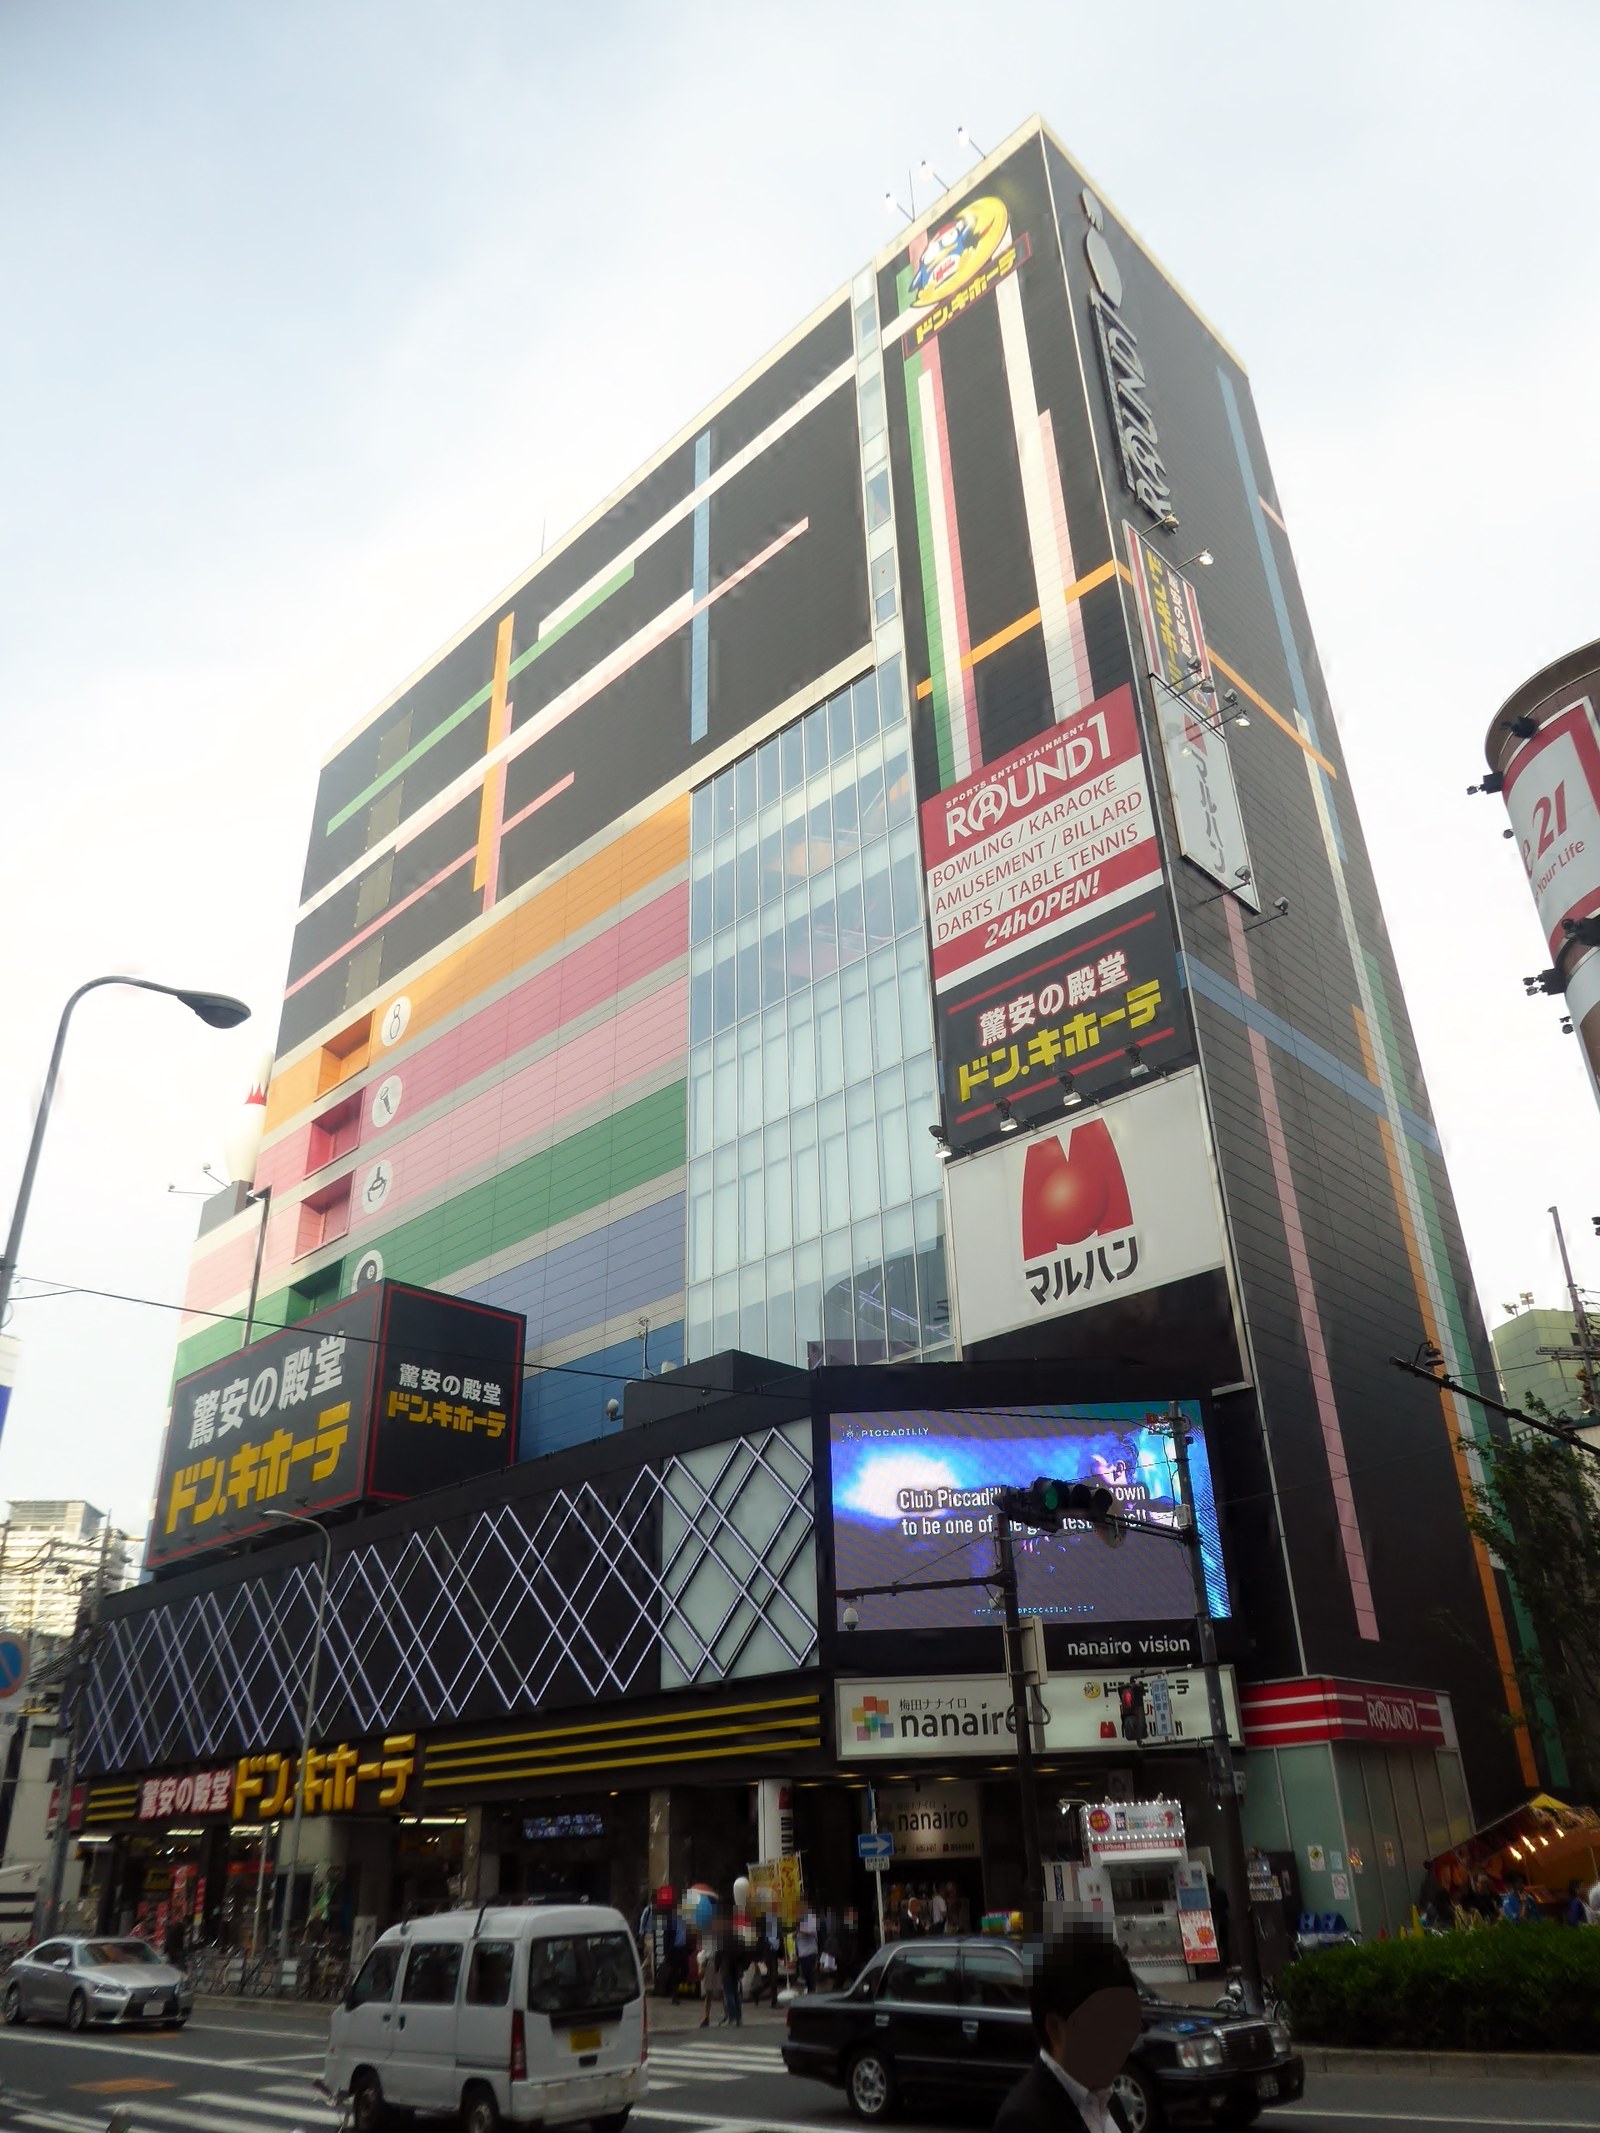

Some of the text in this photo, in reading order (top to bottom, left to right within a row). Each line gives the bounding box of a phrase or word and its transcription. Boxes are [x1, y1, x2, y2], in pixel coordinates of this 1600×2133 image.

[946, 723, 1085, 808] SPORTS ENTERTAINMENT
[946, 711, 1112, 846] ROUND1
[932, 831, 1013, 888] BOWLING
[1030, 774, 1116, 833] KARAOKE
[1192, 753, 1226, 873] マルハン
[1532, 779, 1567, 860] 21
[935, 840, 1042, 914] AMUSEMENT
[1064, 791, 1141, 846] BILLARD
[938, 902, 992, 941] DARTS
[1008, 862, 1064, 904] TABLE
[1068, 823, 1138, 867] TENNIS
[1538, 840, 1584, 896] Your Life
[984, 870, 1100, 949] 24hOPEN!
[980, 950, 1129, 1047] 驚安の殿堂
[1025, 1236, 1138, 1306] マルハン
[188, 1330, 346, 1450] 驚安の殿堂
[399, 1363, 501, 1406] 驚安の殿堂
[862, 1427, 928, 1437] PICCADILLY
[899, 1489, 933, 1509] Club
[902, 1517, 918, 1536] to
[923, 1516, 941, 1534] be
[946, 1519, 973, 1534] one
[978, 1514, 994, 1532] of
[1067, 1636, 1190, 1656] nanairo vision
[900, 1698, 967, 1712] 梅田ナナイロ
[140, 1770, 233, 1820] 驚安の殿堂
[898, 1804, 968, 1832] nanairo
